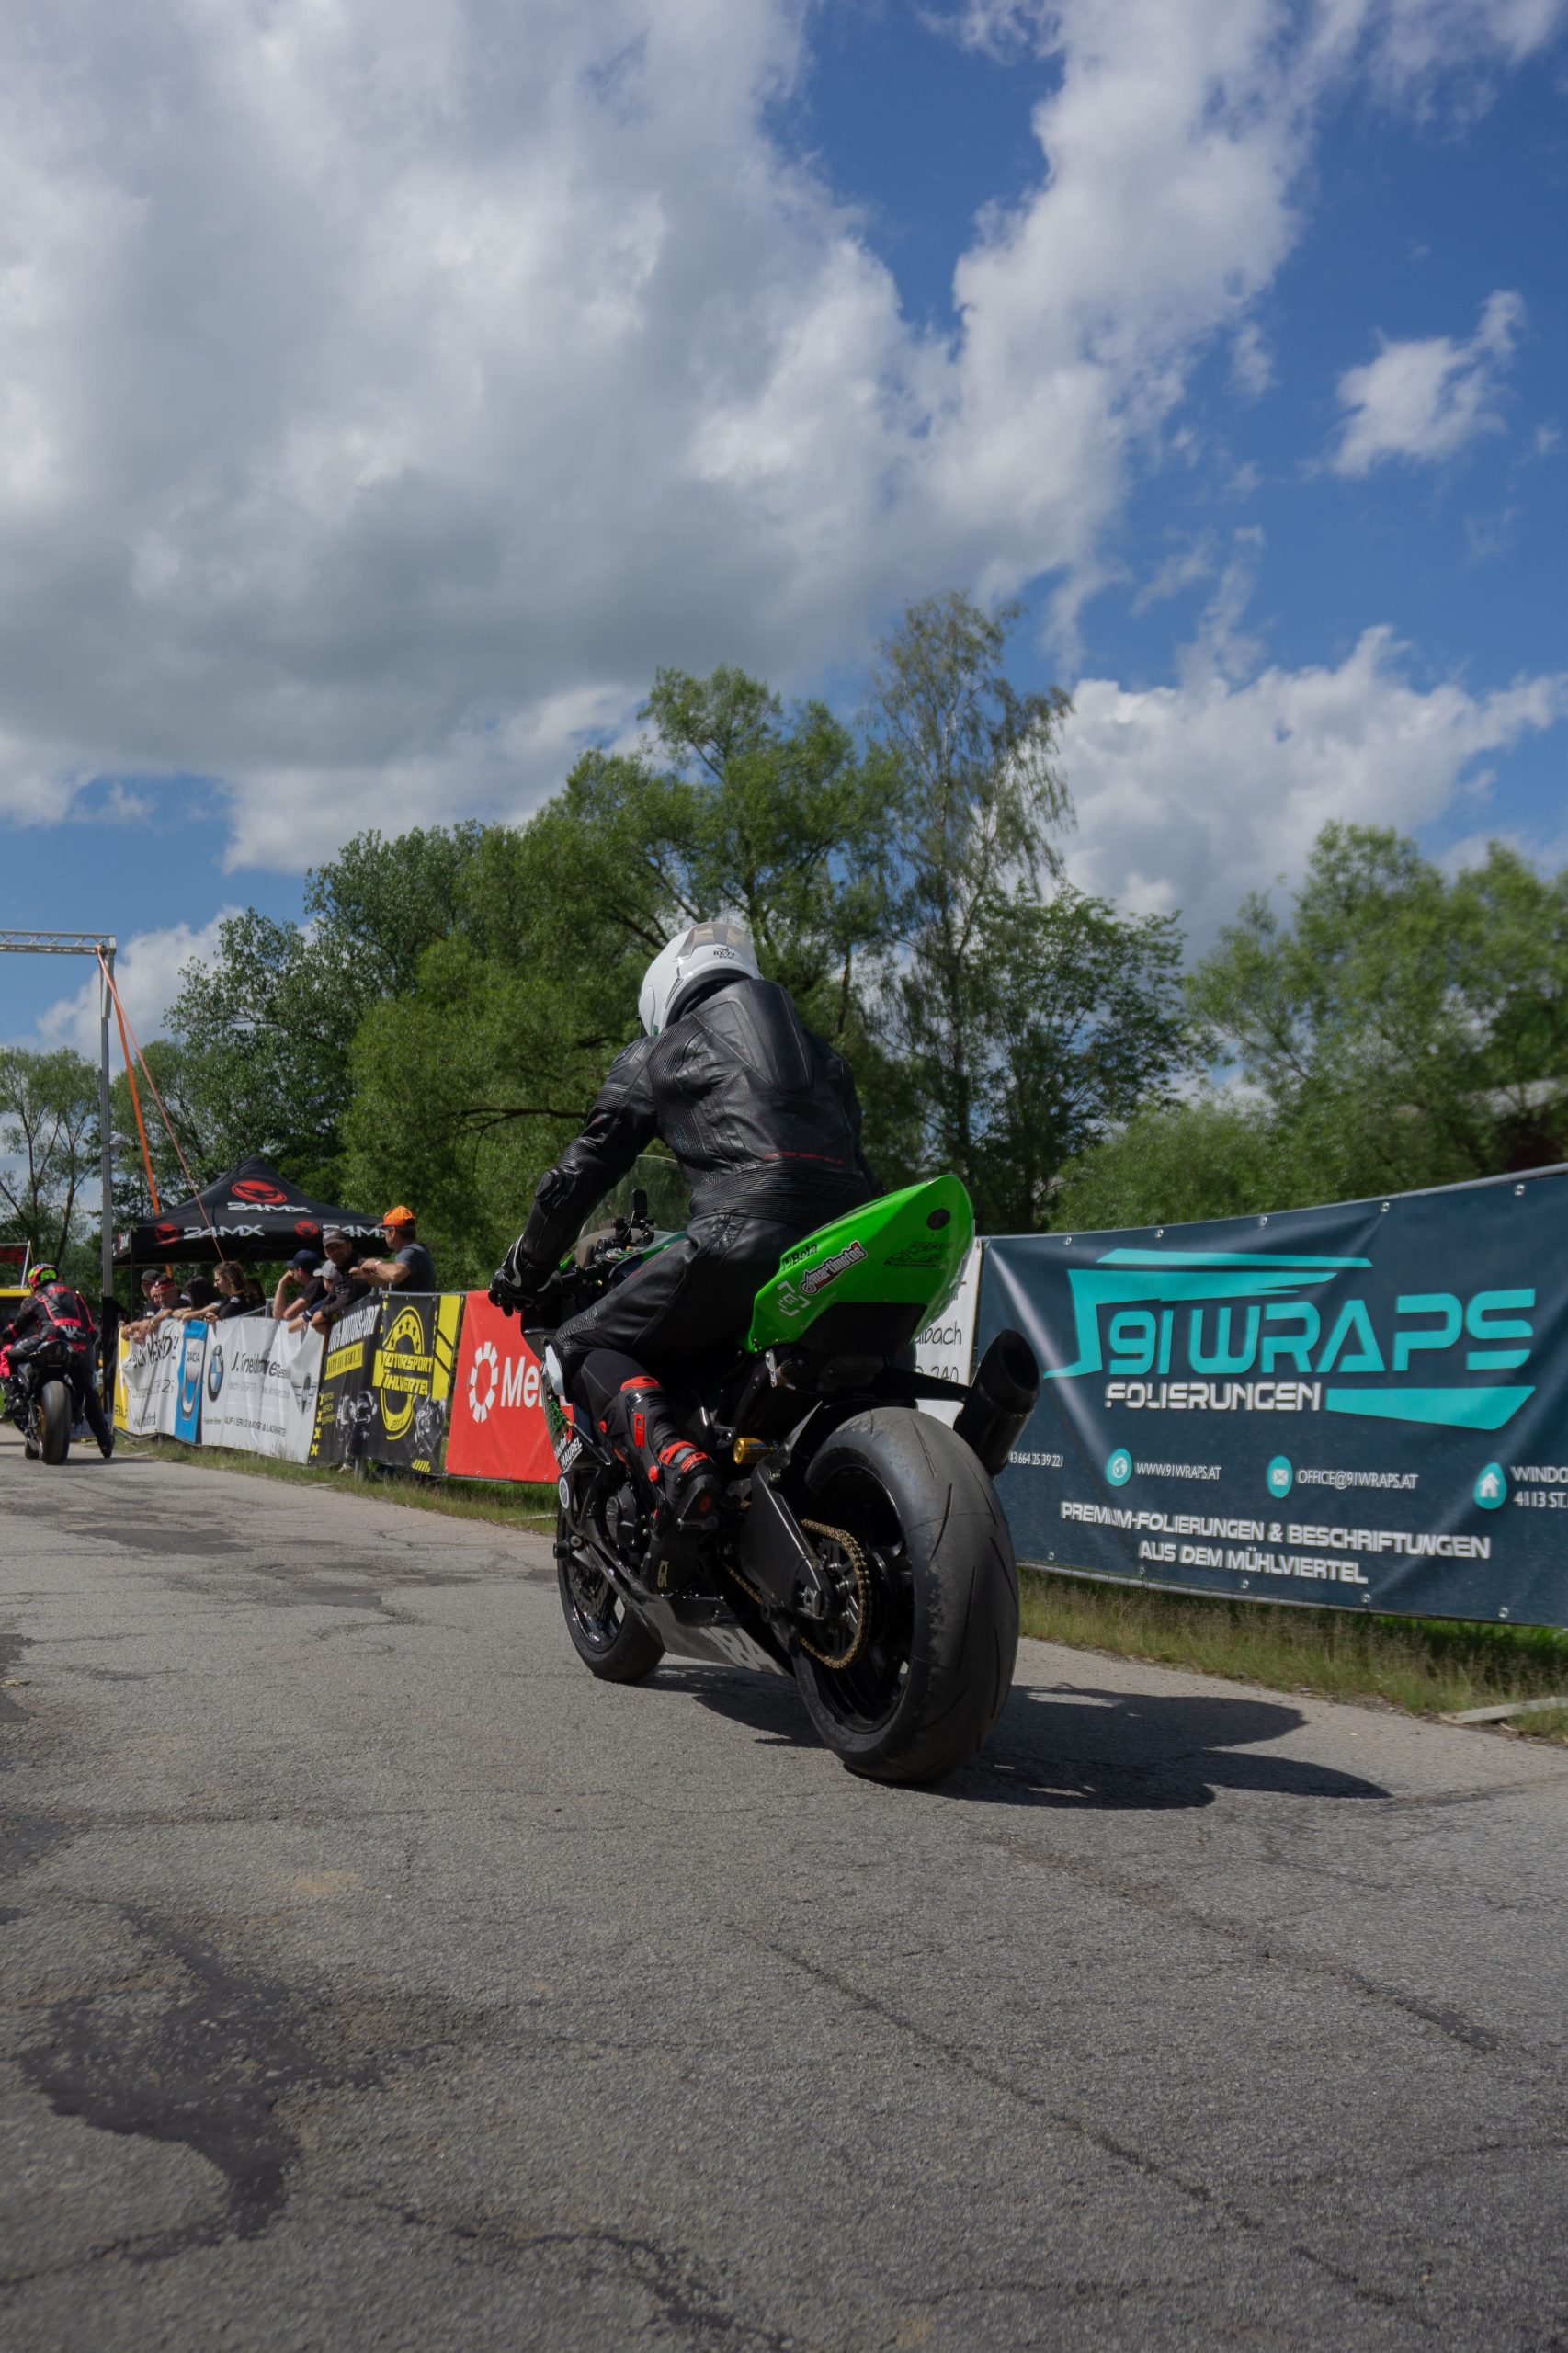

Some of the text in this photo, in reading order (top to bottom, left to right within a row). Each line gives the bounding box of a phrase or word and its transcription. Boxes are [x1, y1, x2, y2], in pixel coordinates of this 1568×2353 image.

[227, 1202, 312, 1213] 24MX
[184, 1224, 265, 1240] 24MX
[1105, 1381, 1322, 1412] FOLIERUNGEN
[1018, 1452, 1031, 1465] 664
[1031, 1453, 1040, 1465] 25
[1040, 1454, 1051, 1466] 39
[1051, 1455, 1064, 1468] 221
[1136, 1462, 1222, 1481] WWW.91WRAPS.AT
[1297, 1469, 1418, 1490] OFFICE@91WRAPS.AT
[1514, 1490, 1546, 1508] 4113
[1061, 1501, 1491, 1560] PREMIUM-FOLIERUNGEN & BESCHRIFTUNGEN
[1139, 1540, 1369, 1585] AUS DEM MÜHLVIERTEL
